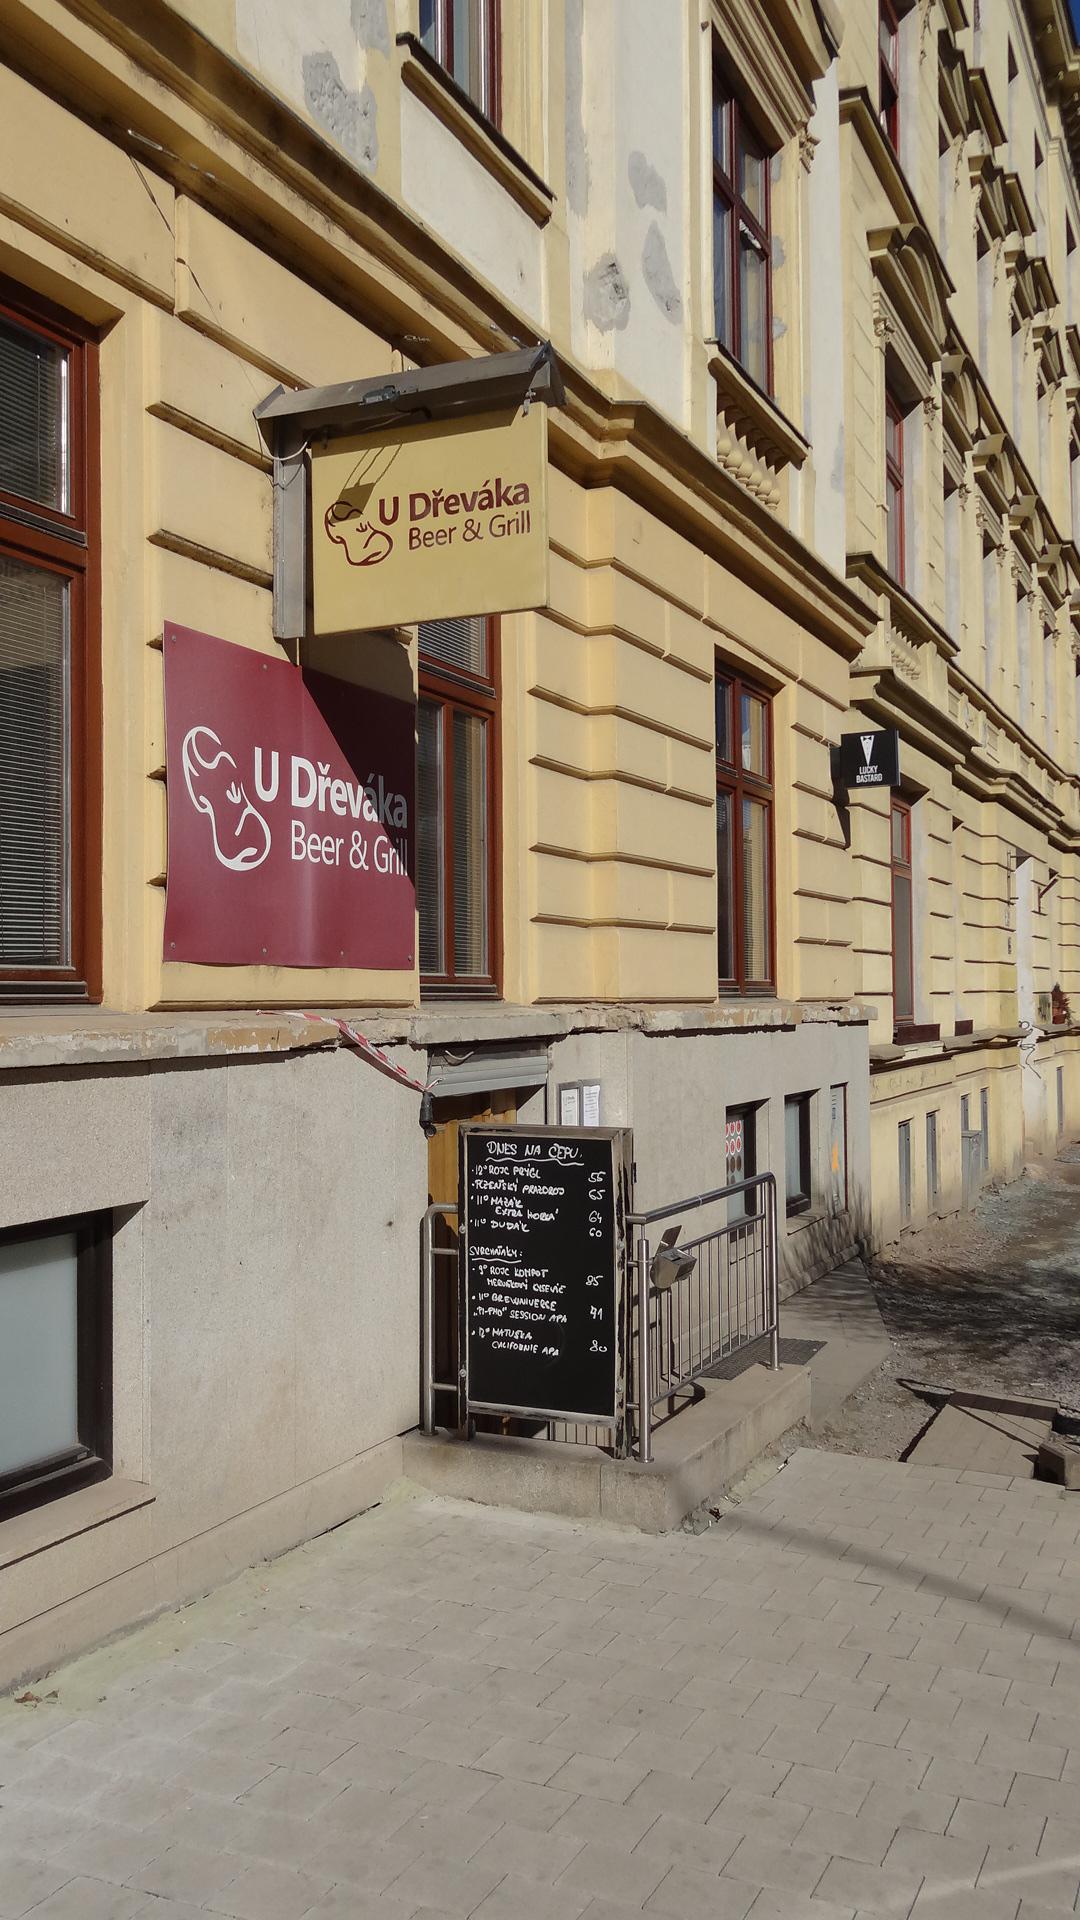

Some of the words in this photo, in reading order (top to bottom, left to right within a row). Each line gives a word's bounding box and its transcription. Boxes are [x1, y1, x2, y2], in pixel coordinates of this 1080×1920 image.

[379, 496, 399, 525] U
[409, 478, 530, 521] Dřeváka
[409, 525, 456, 550] Beer
[462, 519, 483, 542] &
[489, 510, 531, 538] Grill
[860, 765, 878, 774] LUCKY
[856, 773, 882, 783] BASTARD
[255, 747, 279, 802] U
[291, 756, 407, 828] Dřeváka
[292, 820, 344, 865] Beer
[350, 831, 369, 870] &
[374, 836, 408, 876] Grill
[486, 1141, 517, 1155] DNES
[525, 1144, 541, 1156] NA
[588, 1172, 606, 1182] 55
[588, 1190, 605, 1200] 65
[495, 1207, 523, 1218] EXTRA
[589, 1211, 602, 1223] 64
[490, 1220, 530, 1232] DUDÁK
[589, 1228, 602, 1237] 60
[514, 1267, 548, 1277] KOMPOT
[586, 1275, 603, 1286] 85
[509, 1310, 546, 1321] SESSION
[549, 1314, 568, 1323] APA
[542, 1347, 559, 1356] APA
[590, 1340, 607, 1352] 80
